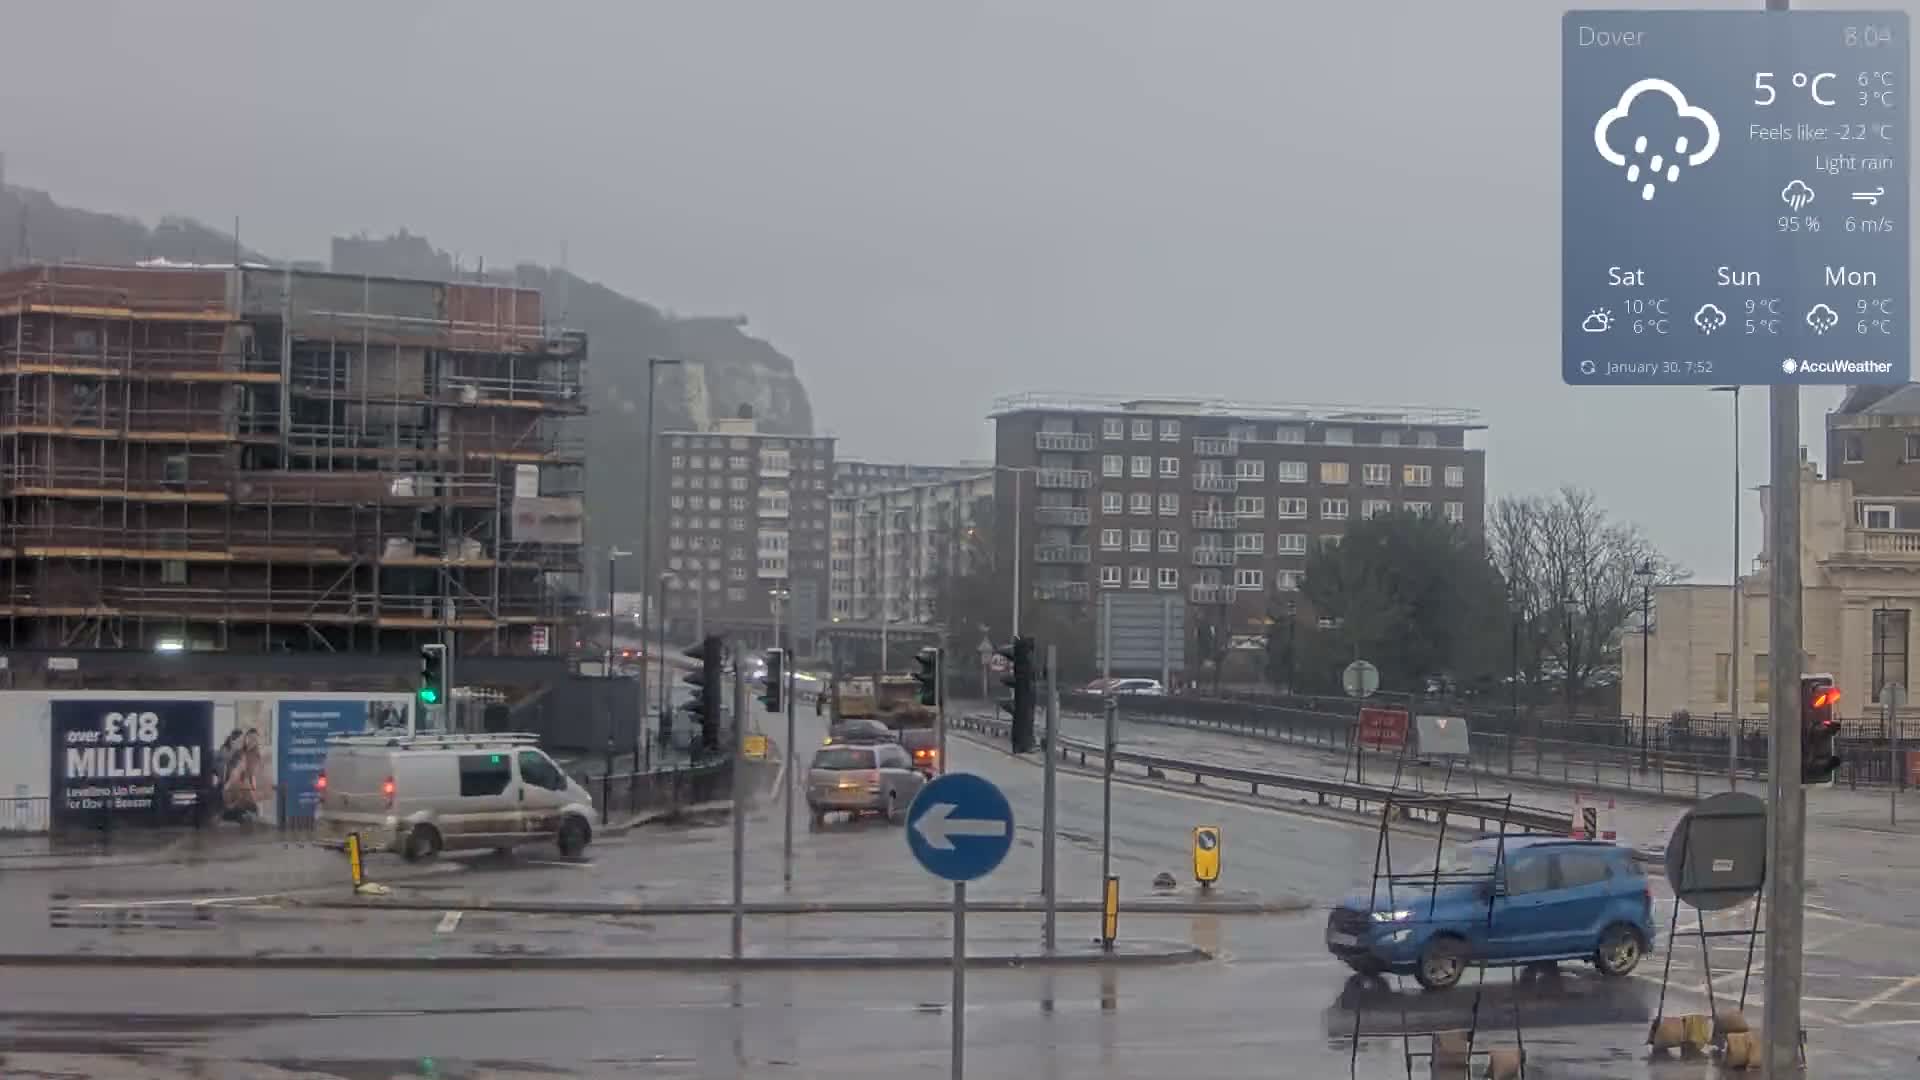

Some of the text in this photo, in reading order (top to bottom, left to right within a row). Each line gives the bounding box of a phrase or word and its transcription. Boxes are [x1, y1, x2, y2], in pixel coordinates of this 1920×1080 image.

[66, 711, 159, 742] over £18
[66, 745, 201, 778] MILLION
